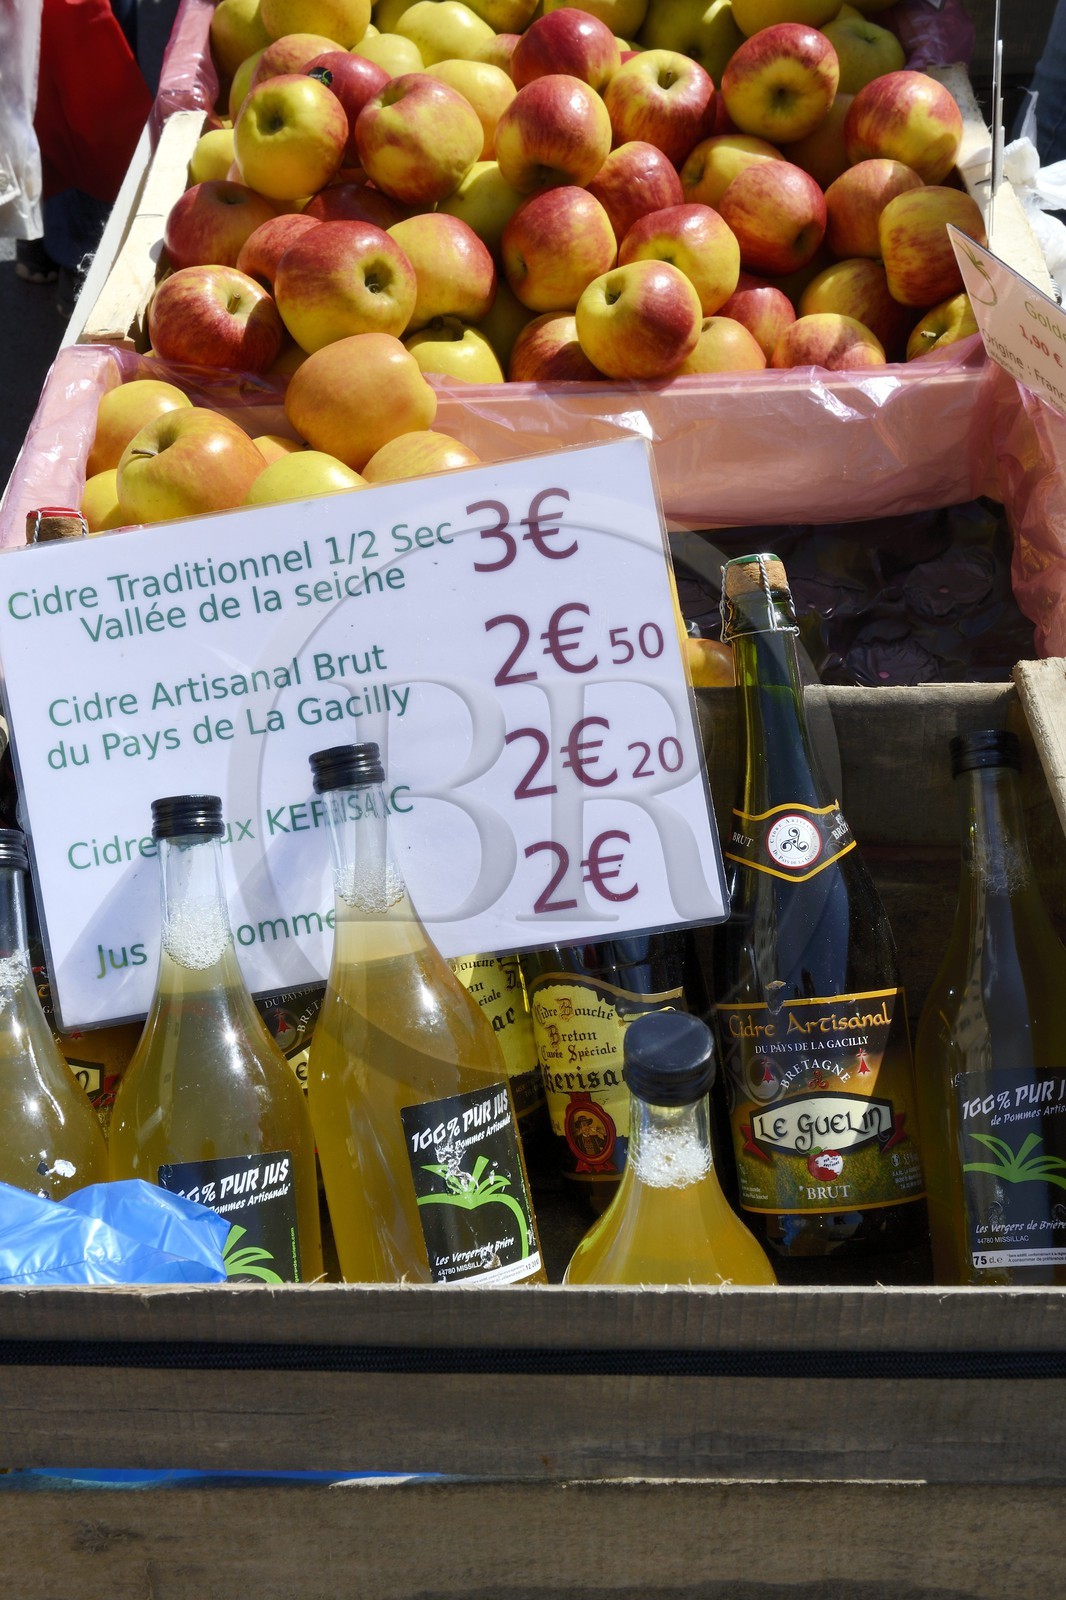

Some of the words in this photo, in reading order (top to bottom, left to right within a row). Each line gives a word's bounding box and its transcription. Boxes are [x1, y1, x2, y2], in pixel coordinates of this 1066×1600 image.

[981, 328, 1024, 369] Origine
[1018, 324, 1049, 357] 1,90
[463, 487, 579, 574] 3€
[7, 584, 99, 623] Cidre
[108, 540, 313, 608] Traditionnel
[324, 529, 377, 570] 1/2
[392, 520, 455, 553] Sec
[79, 603, 187, 643] Vallée
[197, 594, 243, 624] de
[252, 584, 283, 615] la
[294, 562, 406, 607] seiche
[482, 602, 599, 686] 2€
[608, 621, 665, 666] 50
[46, 690, 140, 728] Cidre
[150, 659, 302, 712] Artisanal
[312, 643, 388, 681] Brut
[46, 739, 91, 770] du
[102, 720, 182, 765] Pays
[192, 713, 233, 744] de
[246, 703, 287, 734] La
[299, 683, 412, 729] Gacilly
[503, 716, 620, 800] 2€
[627, 736, 685, 781] 20
[67, 834, 158, 871] Cidre
[731, 831, 755, 848] BRUT
[524, 829, 640, 914] 2€
[96, 942, 149, 980] Jus
[229, 907, 337, 948] omme
[264, 997, 280, 1009] DU
[478, 991, 501, 1007] ciale
[728, 1013, 776, 1038] Cidre
[786, 1001, 893, 1035] Artisanal
[545, 1024, 598, 1050] Breton
[754, 1044, 768, 1055] DU
[769, 1041, 793, 1053] PAYS
[795, 1042, 809, 1051] DE
[811, 1041, 825, 1050] LA
[826, 1035, 869, 1049] GACILLY
[568, 1044, 618, 1064] Spéciale
[543, 1063, 626, 1093] Kerisa
[780, 1059, 851, 1089] BRETAGNE
[962, 1091, 1012, 1120] 100%
[1015, 1080, 1055, 1107] PUR
[411, 1116, 462, 1153] 100%
[462, 1100, 491, 1134] PUR
[493, 1088, 509, 1120] JUS
[758, 1116, 788, 1142] LE
[990, 1114, 1002, 1126] de
[1003, 1109, 1042, 1124] Pommes
[220, 1167, 260, 1200] PUR
[261, 1159, 290, 1190] JUS
[806, 1184, 850, 1200] BRUT
[975, 1224, 989, 1234] Les
[990, 1221, 1025, 1236] Vergers
[1026, 1220, 1038, 1231] de
[977, 1236, 994, 1245] 44780
[994, 1234, 1030, 1245] MISSILLAC
[435, 1254, 450, 1267] Les
[973, 1254, 988, 1266] 75
